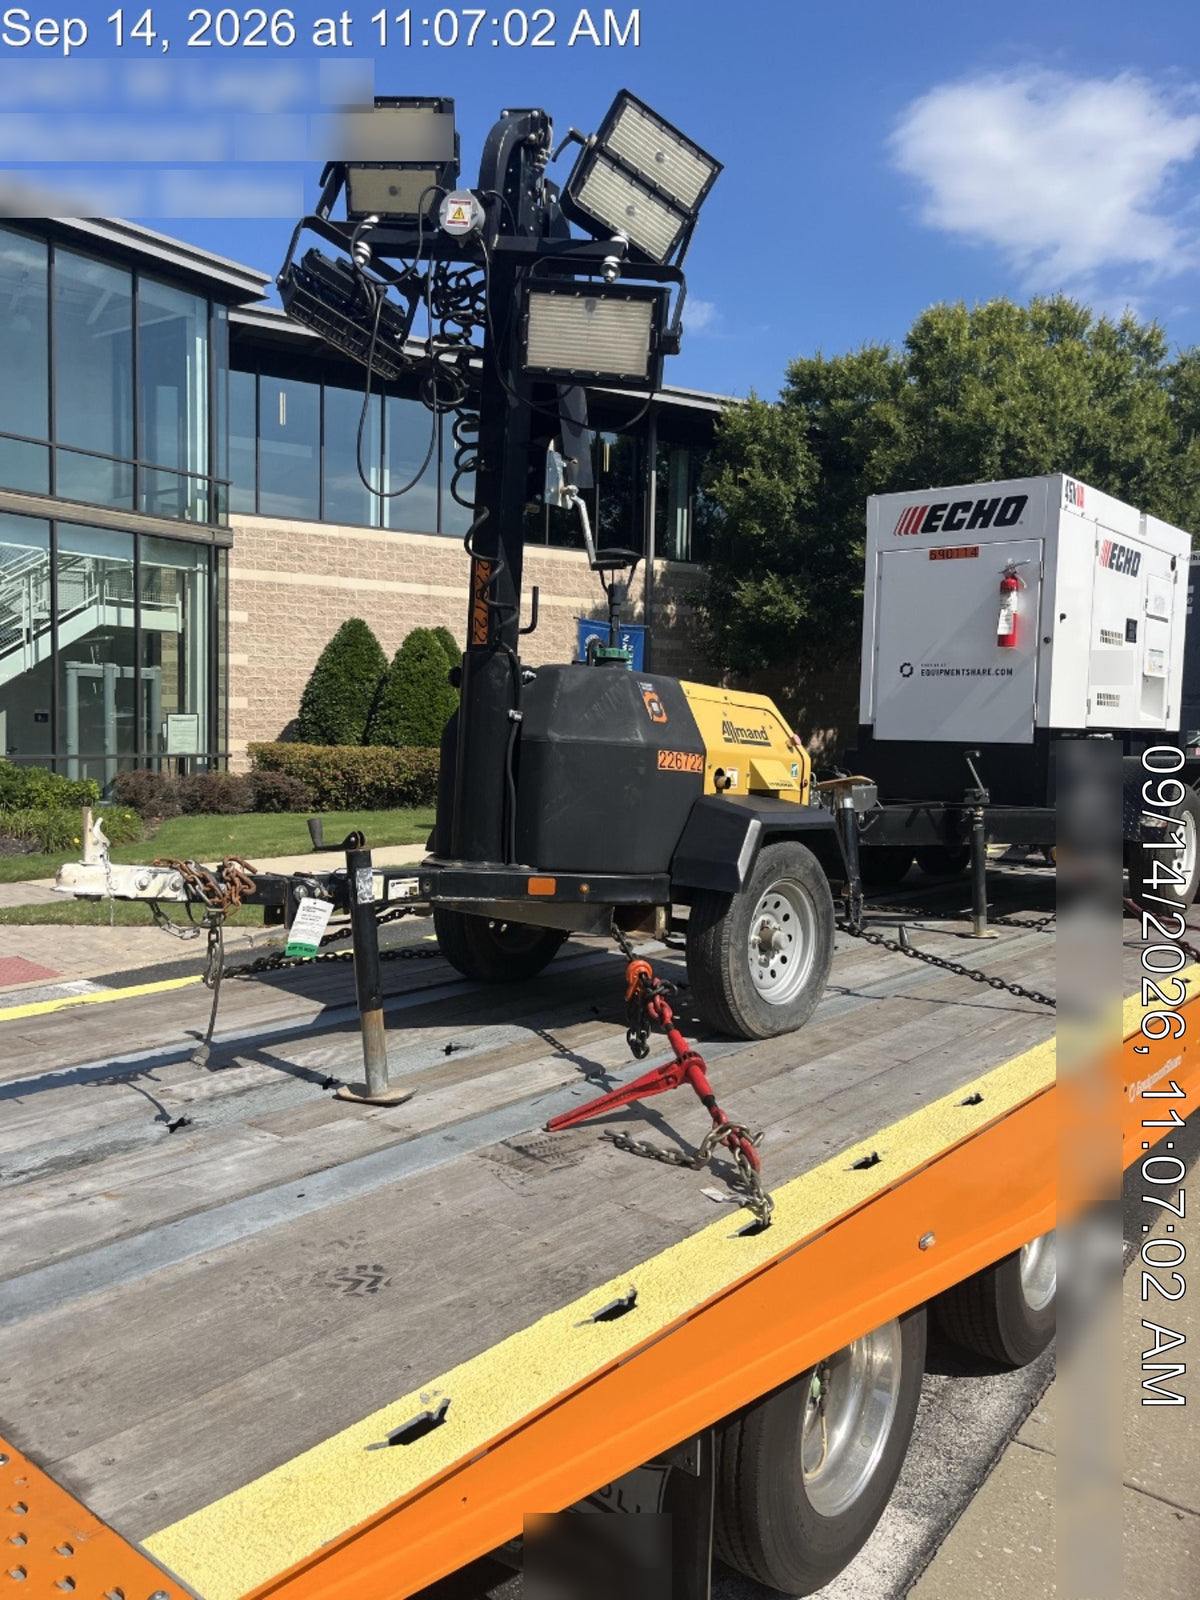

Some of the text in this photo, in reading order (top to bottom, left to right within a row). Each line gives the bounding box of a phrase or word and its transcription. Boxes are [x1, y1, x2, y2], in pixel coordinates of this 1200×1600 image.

[920, 494, 1029, 534] ECHO
[1109, 542, 1141, 578] ECHO
[920, 668, 1013, 677] EQUIPMENTSHARE.COM
[722, 720, 769, 744] Allmand
[658, 751, 703, 773] 226722
